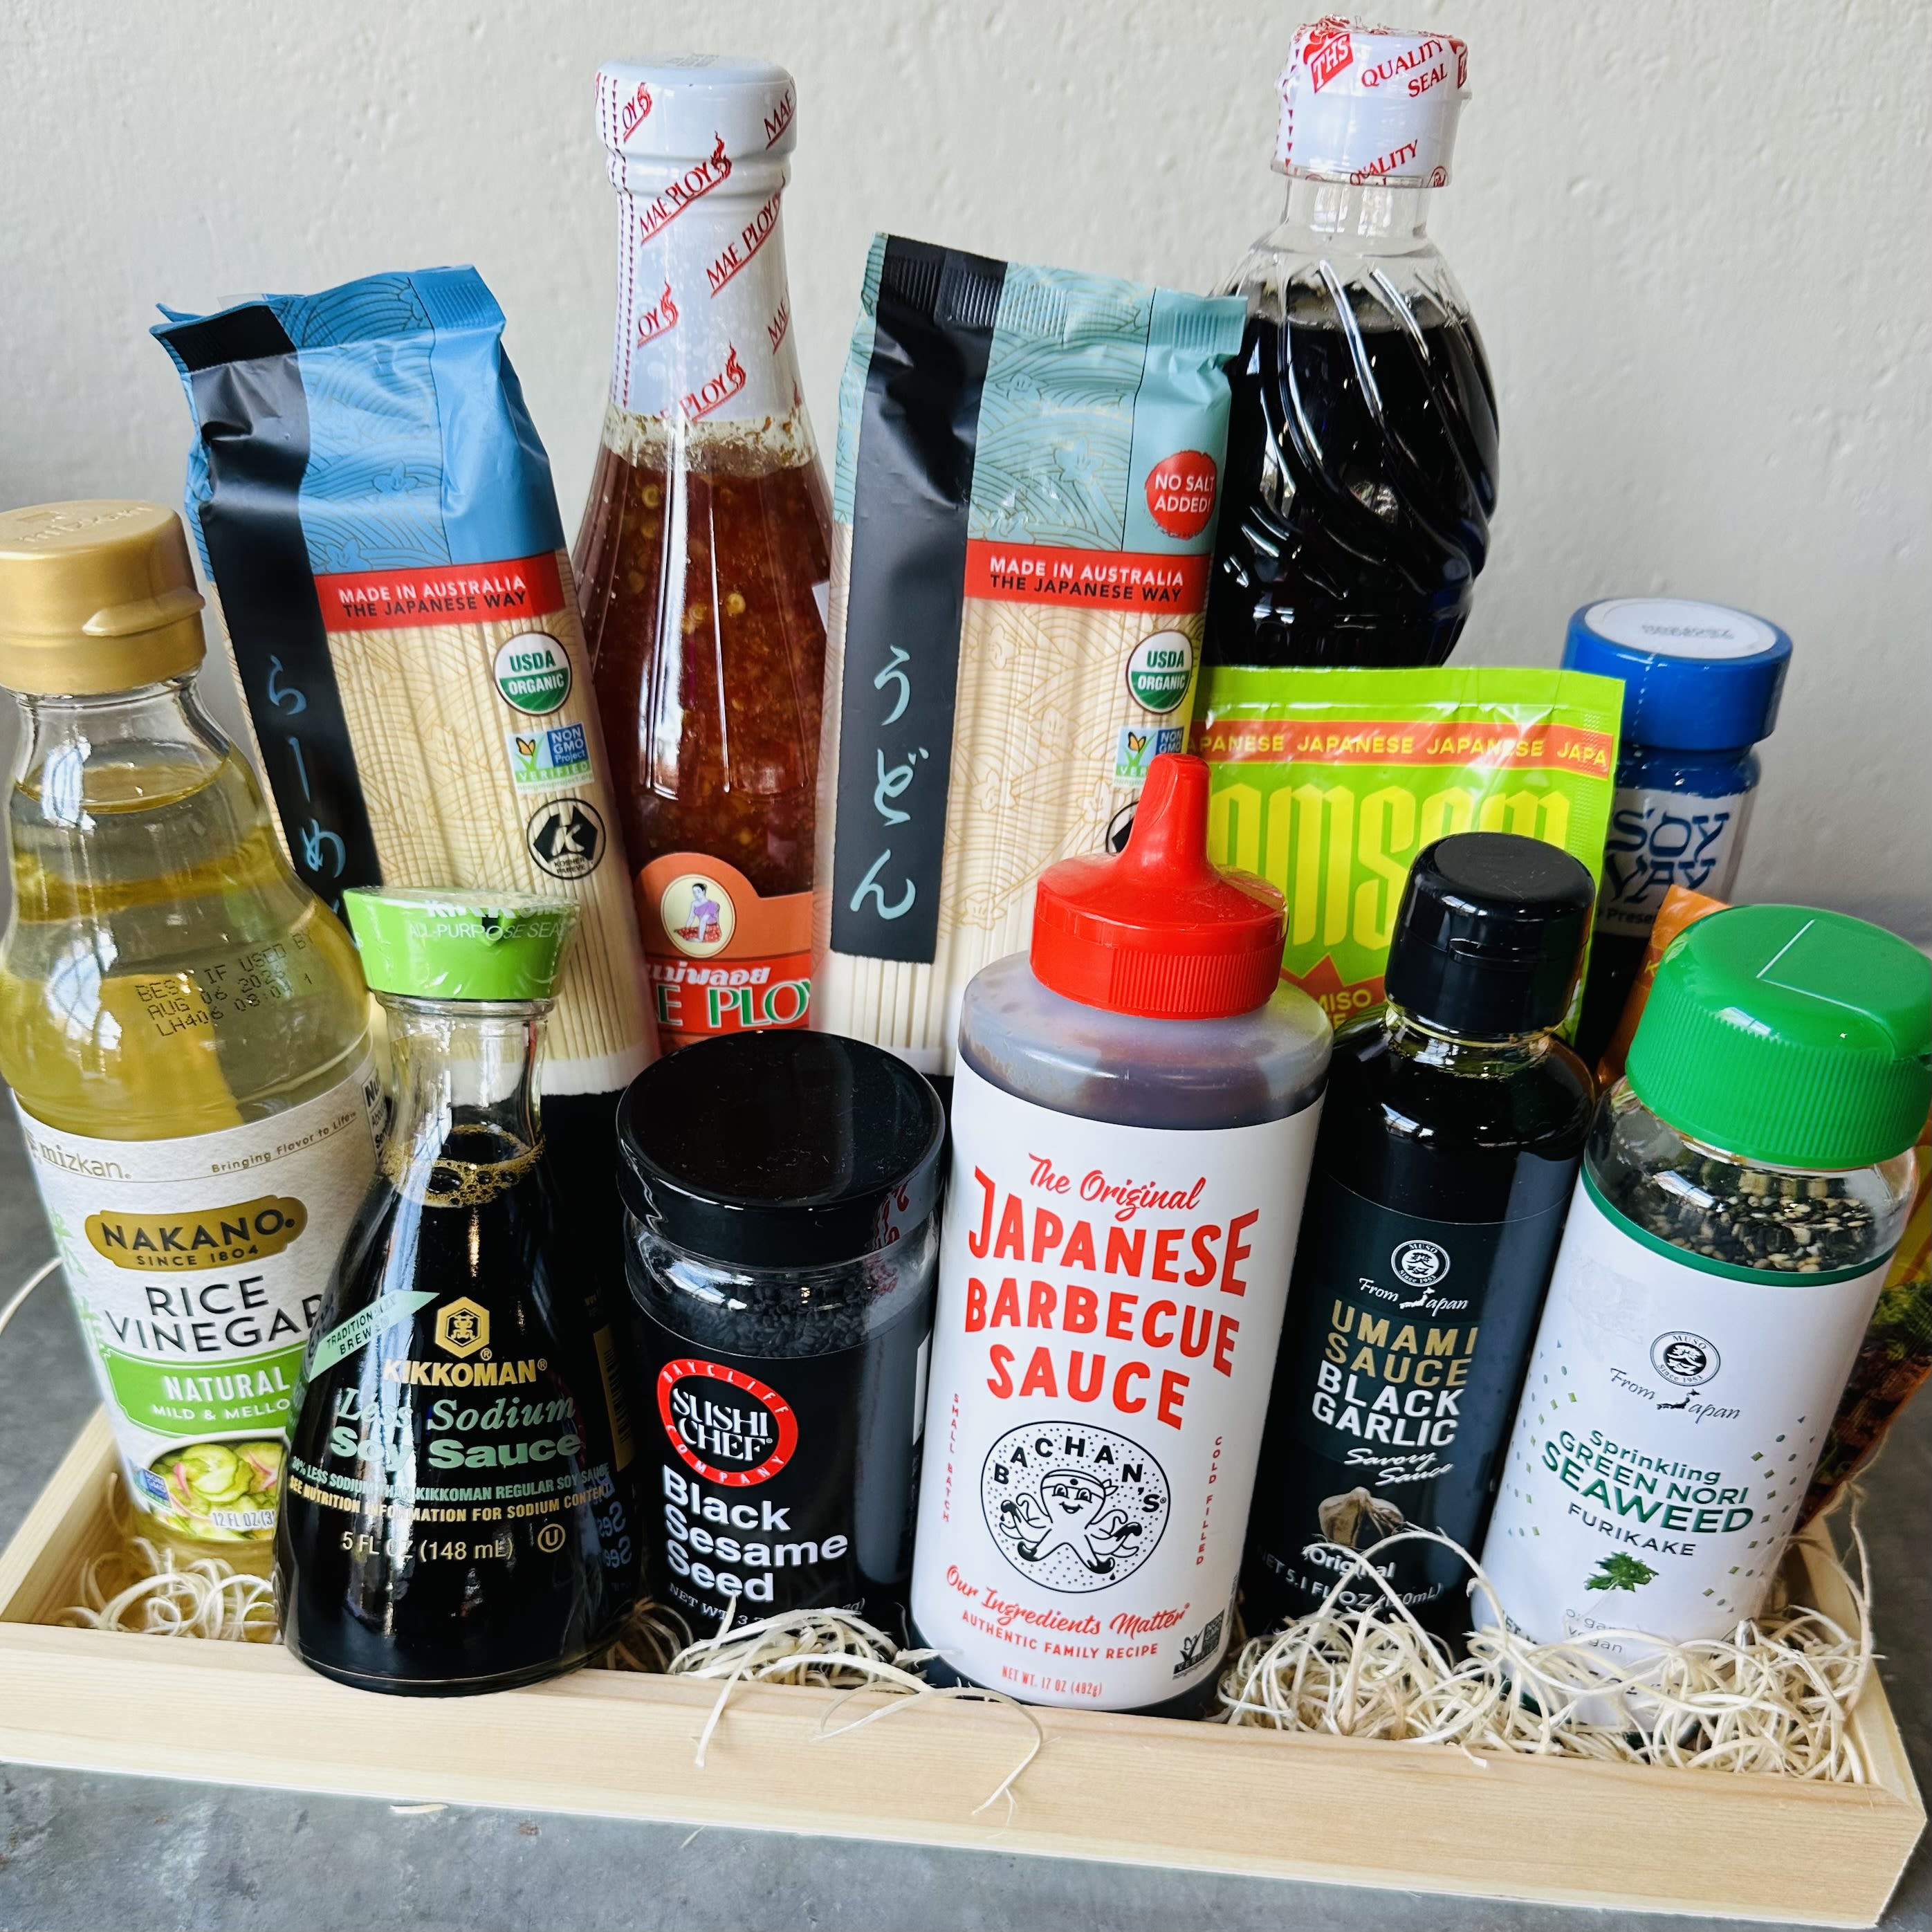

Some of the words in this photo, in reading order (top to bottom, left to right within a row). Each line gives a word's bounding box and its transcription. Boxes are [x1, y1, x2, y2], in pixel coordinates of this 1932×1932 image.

[1313, 36, 1350, 89] THS
[1361, 39, 1444, 87] QUALITY
[1408, 64, 1448, 98] SEAL
[764, 95, 793, 140] MAE
[1350, 140, 1418, 185] QUALITY
[640, 202, 671, 237] MAE
[665, 161, 712, 205] PLOY
[706, 244, 742, 290] MAE
[742, 205, 778, 252] PLOY
[679, 374, 728, 421] PLOY
[1154, 474, 1181, 492] NO
[1185, 475, 1215, 493] SALT
[1154, 494, 1211, 515] ADDED!
[338, 585, 389, 605] MADE
[396, 583, 416, 600] IN
[423, 576, 526, 598] AUSTRALIA
[989, 556, 1045, 577] MADE
[1052, 562, 1074, 580] IN
[1080, 563, 1184, 587] AUSTRALIA
[989, 573, 1027, 592] THE
[1033, 576, 1134, 600] JAPANESE
[1142, 585, 1183, 603] WAY
[343, 601, 378, 618] THE
[385, 596, 478, 616] JAPANESE
[484, 591, 527, 608] WAY
[509, 650, 557, 673] USDA
[1146, 650, 1184, 669] USDA
[508, 672, 565, 695] ORGANIC
[1137, 674, 1186, 691] ORGANIC
[551, 726, 582, 744] NON
[553, 739, 585, 755] GMO
[1158, 742, 1182, 754] GMO
[1160, 730, 1183, 743] NON
[1296, 734, 1415, 755] JAPANESE
[1426, 735, 1544, 759] JAPANESE
[519, 761, 589, 782] VERIFIED
[555, 749, 586, 764] Project
[203, 964, 228, 985] IF
[238, 942, 287, 973] USED
[292, 930, 315, 950] BY
[147, 997, 190, 1021] AUG
[200, 985, 228, 1006] 06
[156, 1006, 224, 1038] LH406
[212, 1150, 272, 1174] Bringing
[276, 1134, 315, 1155] Flavor
[318, 1125, 330, 1138] to
[1028, 1152, 1071, 1195] The
[1079, 1169, 1206, 1222] Original
[968, 1165, 1260, 1298] JAPANESE
[1408, 1242, 1438, 1254] MUSO
[137, 1253, 198, 1267] SINCE
[210, 1245, 259, 1264] 1804
[145, 1275, 269, 1318] RICE
[1359, 1276, 1399, 1303] From
[964, 1276, 1240, 1378] BARBECUE
[1332, 1299, 1479, 1356] UMAMI
[1672, 1335, 1707, 1350] MUSO
[1325, 1332, 1472, 1388] SAUCE
[1659, 1363, 1680, 1382] Since
[1682, 1374, 1704, 1383] 1953
[163, 1366, 291, 1403] NATURAL
[662, 1361, 789, 1414] BAYCLIFF
[986, 1343, 1190, 1431] SAUCE
[1316, 1359, 1466, 1418] BLACK
[1610, 1367, 1656, 1401] From
[152, 1403, 196, 1420] MILD
[204, 1409, 217, 1420] &
[225, 1398, 291, 1419] MELLO
[336, 1386, 414, 1428] Less
[428, 1396, 576, 1432] Sodium
[672, 1388, 769, 1437] SUSHI
[948, 1392, 960, 1455] SMALL
[1312, 1391, 1459, 1447] GARLIC
[330, 1426, 414, 1472] Soy
[428, 1433, 582, 1470] Sauce
[1208, 1435, 1223, 1485] COLD
[1343, 1447, 1439, 1472] Savory
[1558, 1430, 1658, 1495] GREEN
[1666, 1480, 1749, 1506] NORI
[1589, 1430, 1722, 1486] Sprinkling
[306, 1464, 329, 1485] LESS
[415, 1487, 492, 1502] KIKKOMAN
[495, 1479, 554, 1500] REGULAR
[557, 1473, 579, 1491] SOY
[581, 1462, 610, 1484] SAUCE
[942, 1462, 953, 1522] BATCH
[1374, 1462, 1454, 1487] Sauce
[1541, 1439, 1754, 1534] SEAWEED
[289, 1475, 304, 1495] SEE
[304, 1482, 361, 1514] NUTRITION
[365, 1501, 466, 1522] INFORMATION
[472, 1507, 502, 1522] FOR
[506, 1498, 560, 1519] SODIUM
[564, 1483, 610, 1509] CONTENT
[663, 1464, 791, 1532] Black
[212, 1512, 226, 1527] 12
[228, 1513, 240, 1527] FL
[243, 1512, 259, 1527] OZ
[664, 1502, 849, 1567] Sesame
[1195, 1494, 1214, 1565] FILLED
[1567, 1502, 1697, 1557] FURIKAKE
[342, 1531, 354, 1552] 5
[358, 1534, 380, 1556] FL
[419, 1539, 467, 1562] (148
[475, 1536, 513, 1560] mL)
[665, 1537, 775, 1603] Seed
[669, 1583, 699, 1608] NET
[946, 1564, 979, 1599] Our
[980, 1587, 1101, 1635] Ingredients
[1338, 1590, 1374, 1608] OZ
[962, 1609, 1038, 1651] AUTHENTIC
[1044, 1641, 1101, 1659] FAMILY
[1106, 1643, 1159, 1659] RECIPE
[1001, 1664, 1019, 1682] NET
[1021, 1669, 1039, 1686] WT.
[1040, 1675, 1052, 1690] 17
[1054, 1677, 1067, 1693] OZ
